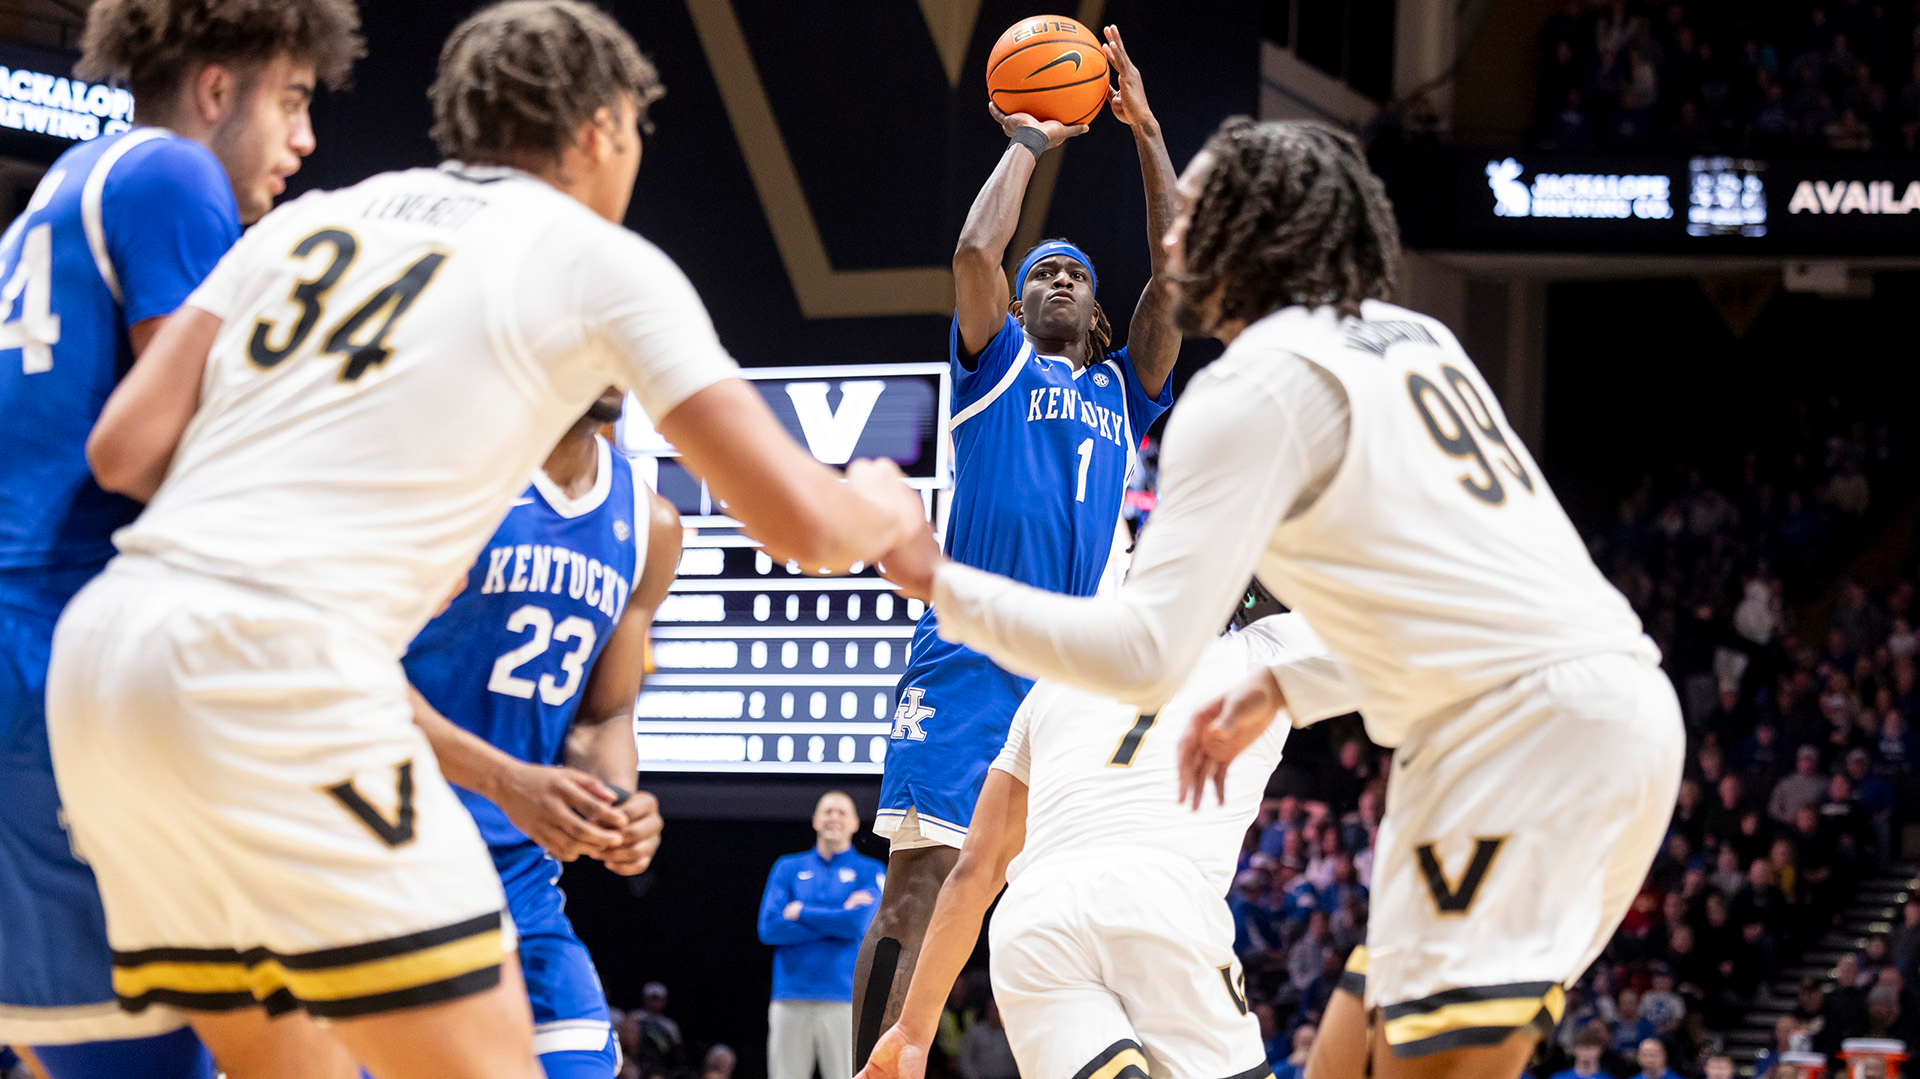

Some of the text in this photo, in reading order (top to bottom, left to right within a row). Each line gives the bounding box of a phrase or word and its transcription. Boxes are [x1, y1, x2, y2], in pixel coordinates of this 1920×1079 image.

[1013, 21, 1079, 43] ELITE
[0, 64, 135, 122] ACKALOP
[246, 225, 453, 385] 34
[785, 380, 887, 465] V
[1026, 387, 1123, 447] KENUKY
[1405, 362, 1535, 509] 99
[1075, 437, 1095, 503] 1
[481, 544, 629, 626] KENTUCKY
[487, 604, 597, 706] 23
[318, 758, 417, 849] V
[1415, 835, 1509, 920] V
